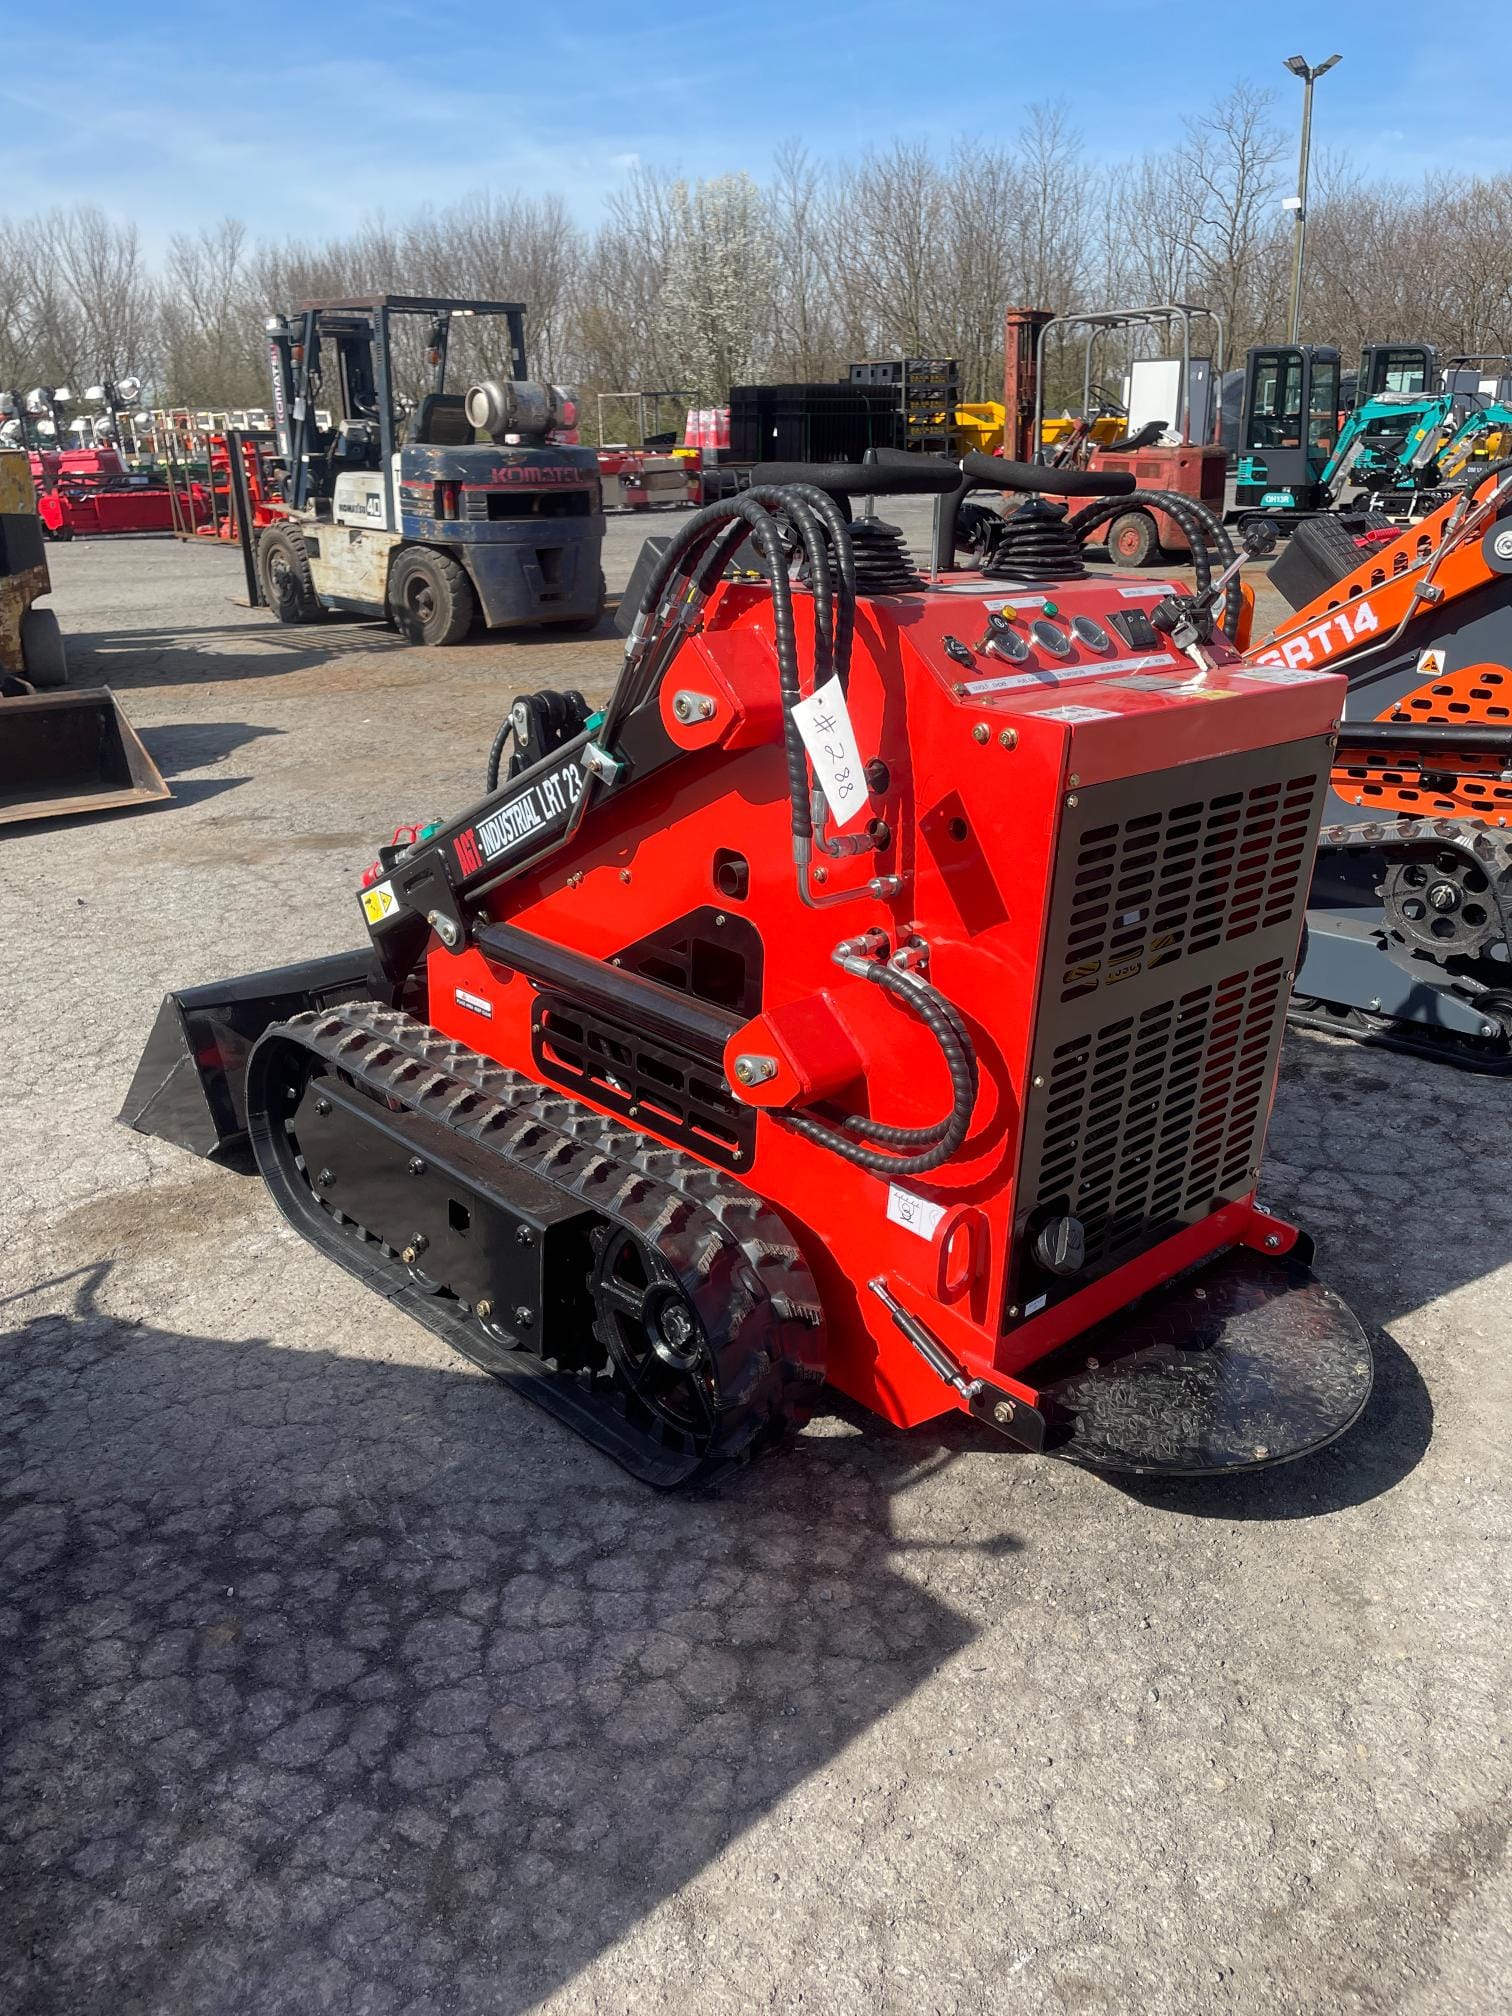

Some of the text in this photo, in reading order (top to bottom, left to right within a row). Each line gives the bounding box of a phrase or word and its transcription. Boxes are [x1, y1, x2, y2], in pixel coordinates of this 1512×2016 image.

[366, 497, 381, 516] 40
[452, 763, 584, 878] AGT INDUSTRIAL LRT 23
